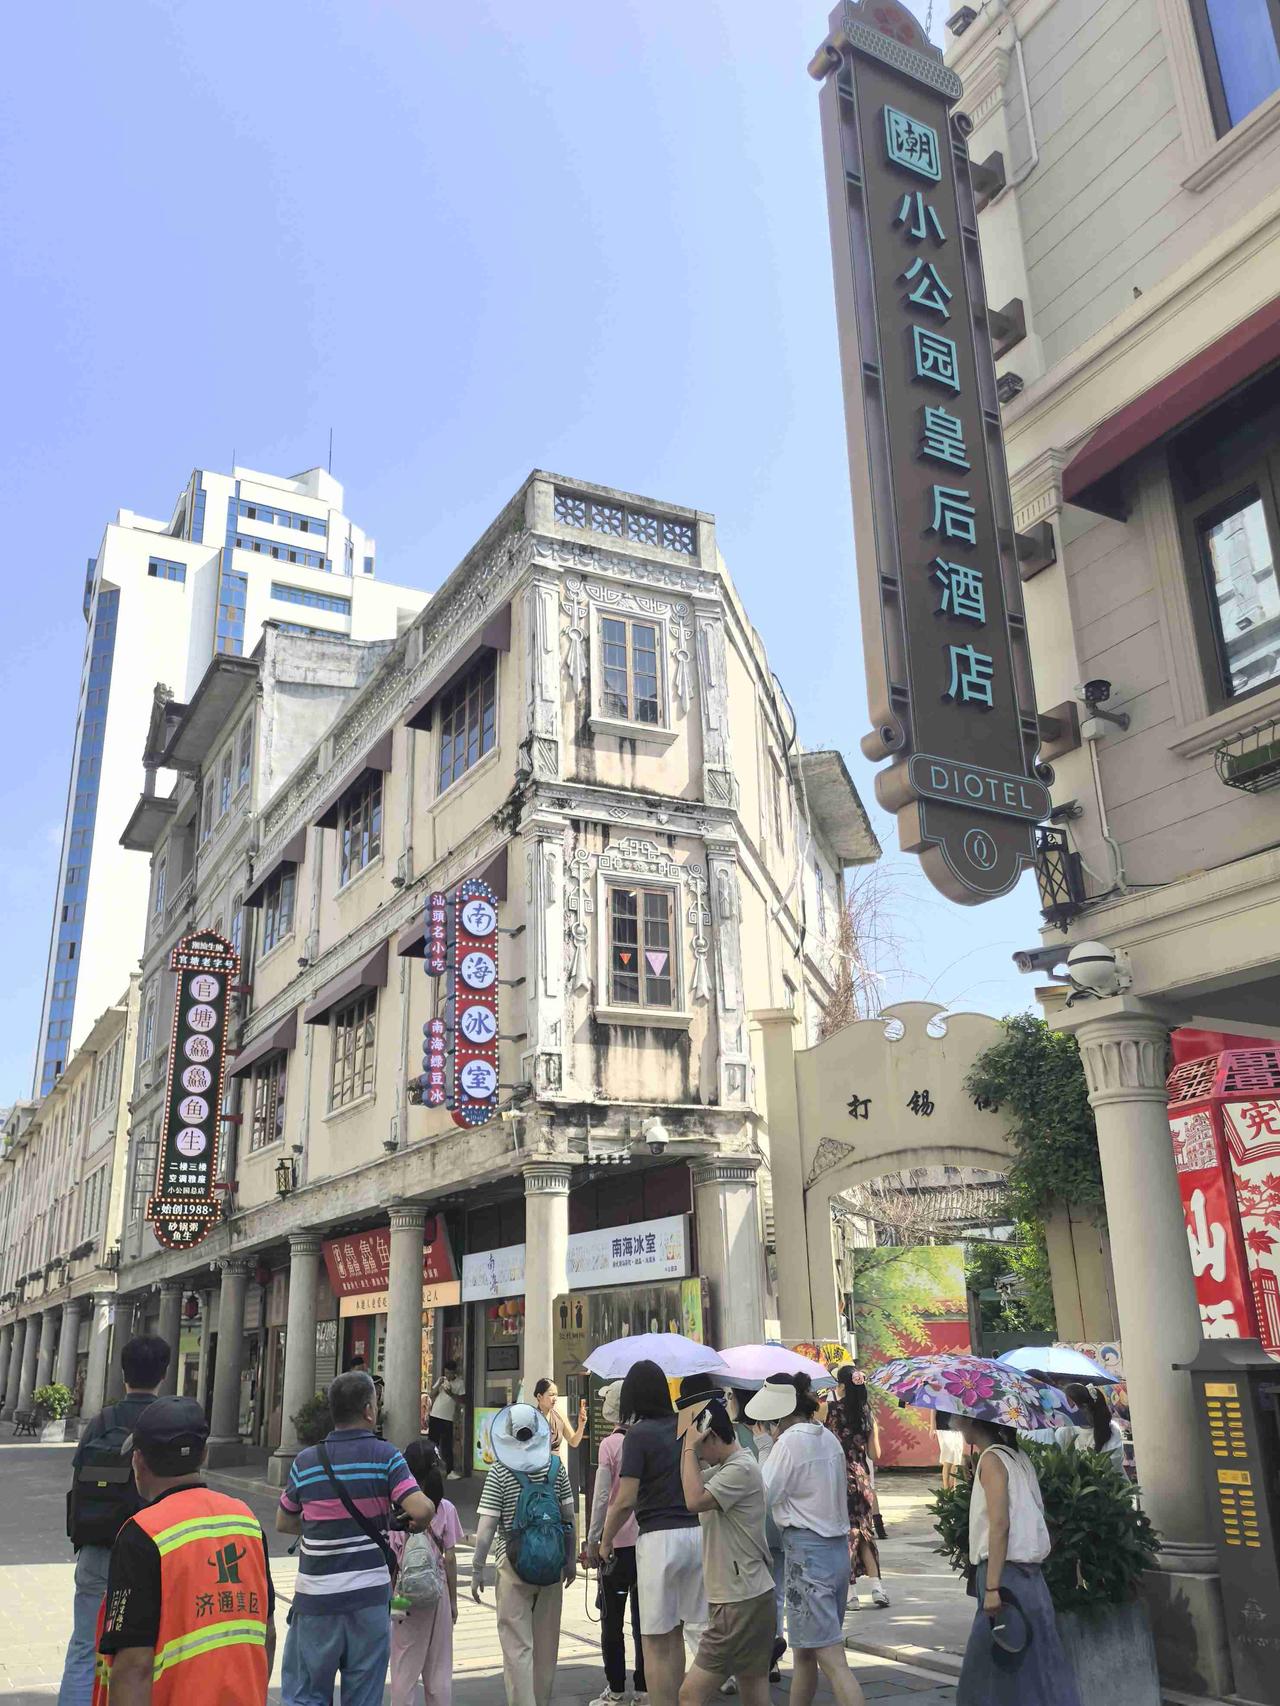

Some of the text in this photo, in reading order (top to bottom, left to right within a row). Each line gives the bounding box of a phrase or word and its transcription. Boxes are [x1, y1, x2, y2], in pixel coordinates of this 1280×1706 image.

[930, 764, 1033, 811] DIOTEL
[178, 954, 234, 969] 官塘老字号
[464, 903, 494, 1092] 南海冰室
[169, 1162, 207, 1172] 二楼三楼
[168, 1174, 207, 1184] 空调雅座
[167, 1186, 206, 1195] 小公园总店
[168, 1221, 199, 1232] 砂锅粥
[172, 1230, 192, 1241] 鱼生
[612, 1232, 656, 1259] 南海冰室
